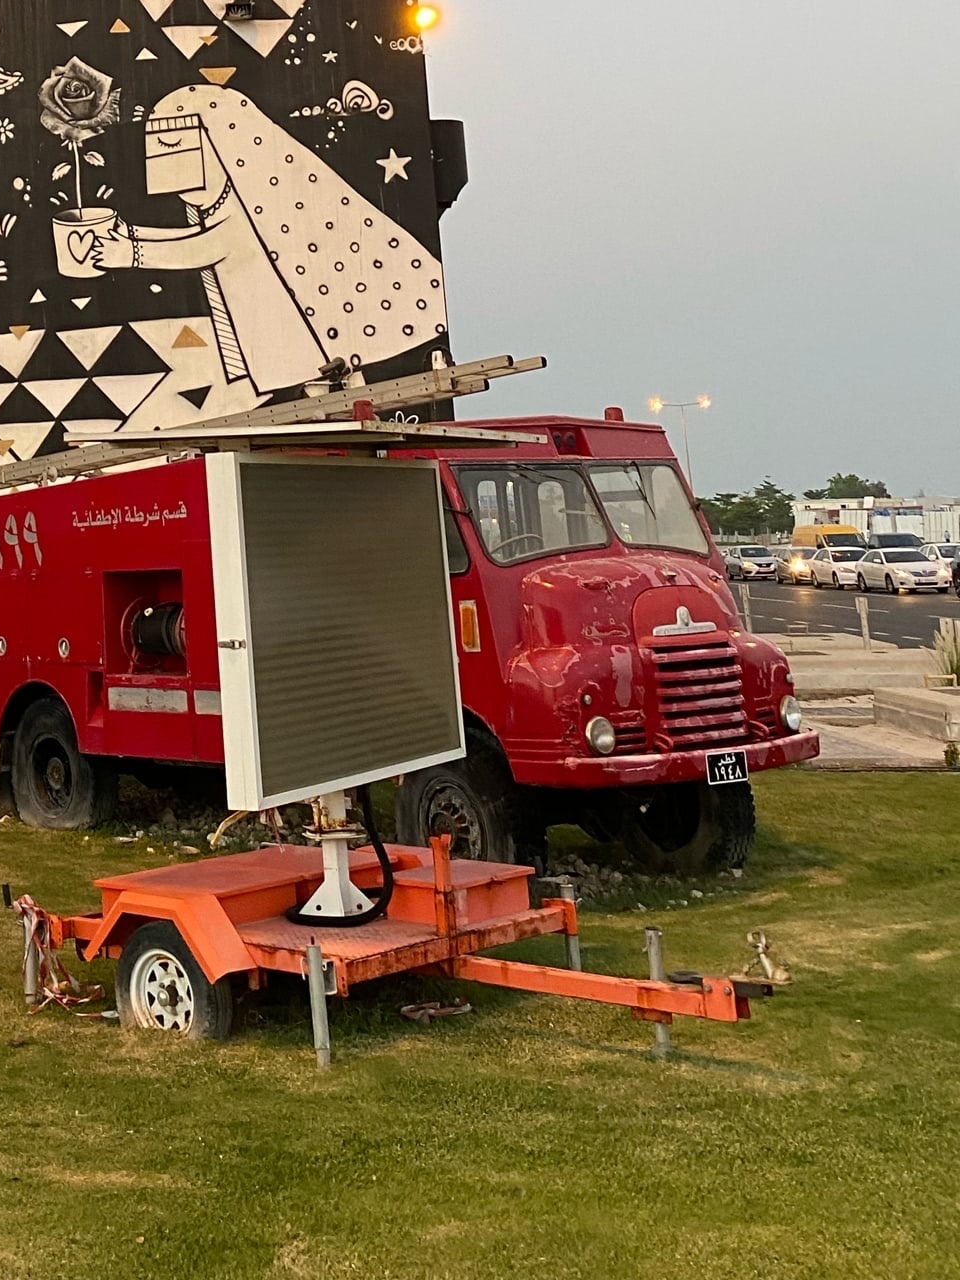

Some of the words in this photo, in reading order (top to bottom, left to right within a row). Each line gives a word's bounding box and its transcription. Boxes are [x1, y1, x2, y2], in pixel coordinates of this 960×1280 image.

[71, 506, 122, 532] الإطفائية
[123, 502, 161, 527] شرطة
[162, 500, 188, 527] قسم
[717, 752, 737, 766] قطر
[714, 764, 743, 781] ١٩٤٨
